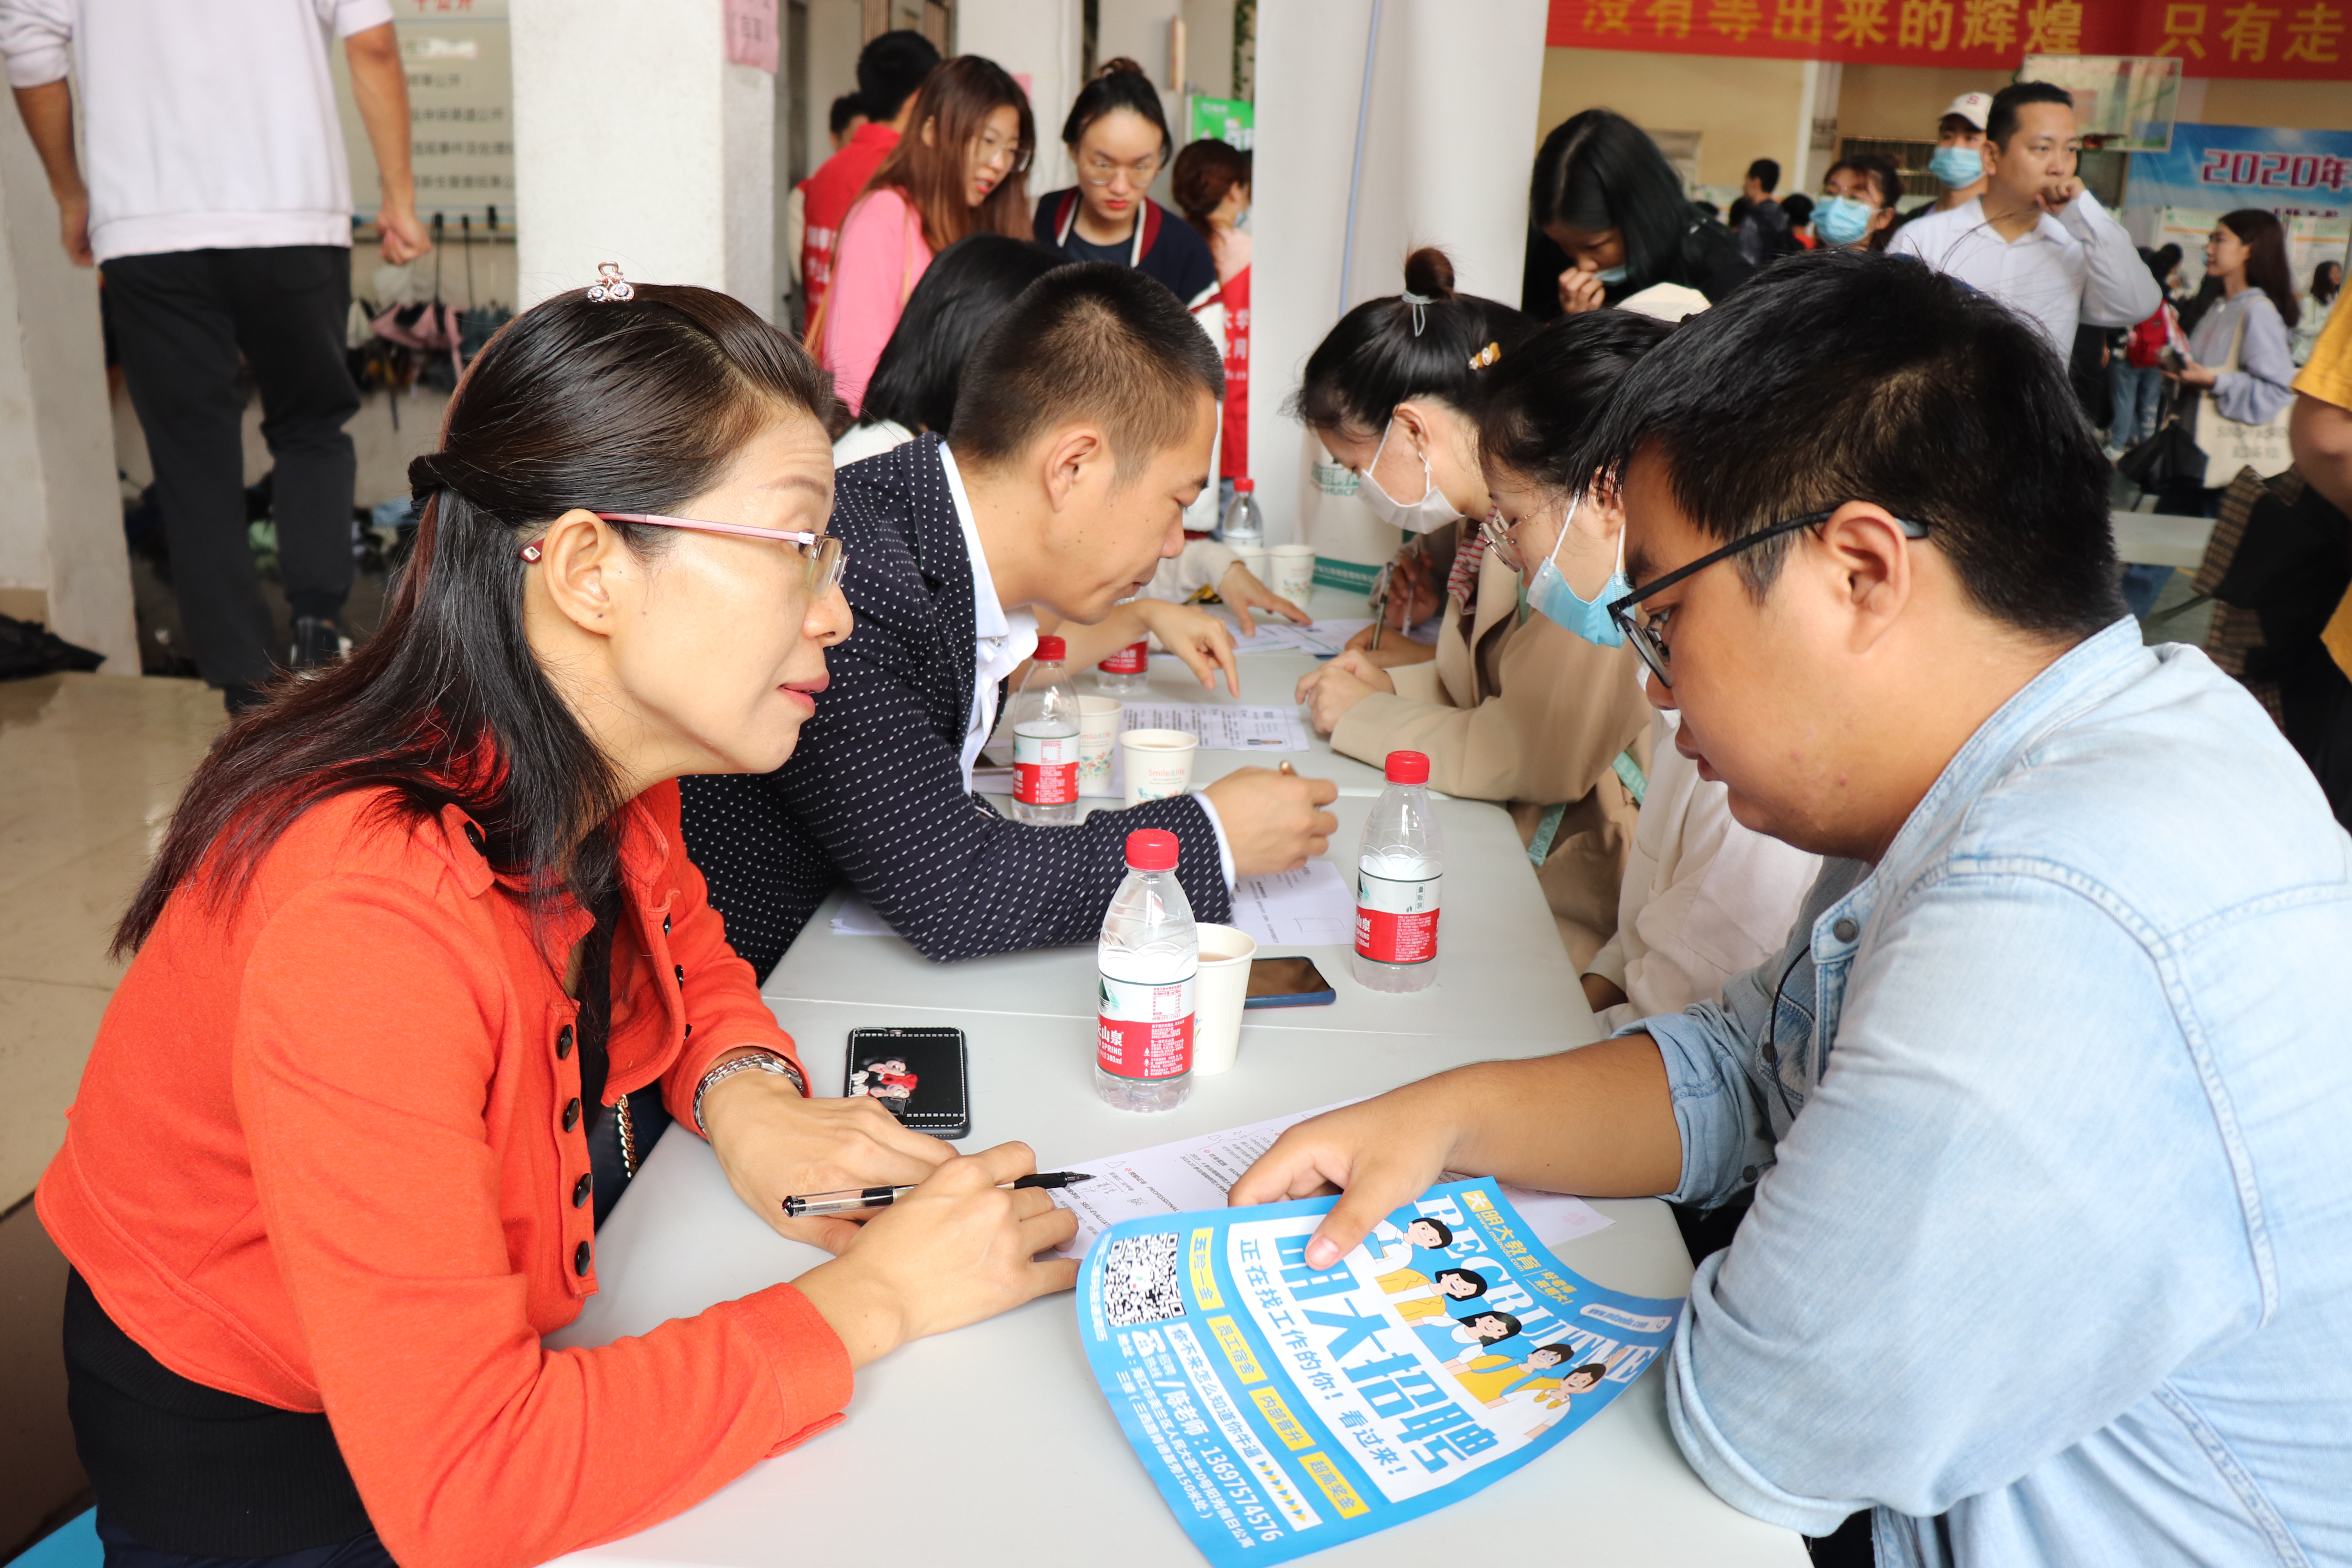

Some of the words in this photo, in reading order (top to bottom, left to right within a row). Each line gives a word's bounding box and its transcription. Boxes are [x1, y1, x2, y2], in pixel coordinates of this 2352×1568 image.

[1582, 0, 2082, 55] 没有等出来的辉煌
[2154, 2, 2345, 63] 只有走
[2201, 148, 2352, 192] 2020年
[1102, 1041, 1123, 1056] SPRING
[1080, 1201, 1112, 1229] SELF-EVALUATI
[1147, 1186, 1180, 1214] PROFESSIONAL
[1475, 1213, 1525, 1272] www.mdaedu.com
[1481, 1208, 1541, 1271] 明大教育
[1193, 1236, 1214, 1301] 五险一金
[1216, 1325, 1255, 1374] 员工宿舍
[1171, 1328, 1263, 1458] 你不来怎么知道你牛逼
[1258, 1395, 1304, 1443] 内部晋升
[1308, 1457, 1356, 1511] 超高奖金
